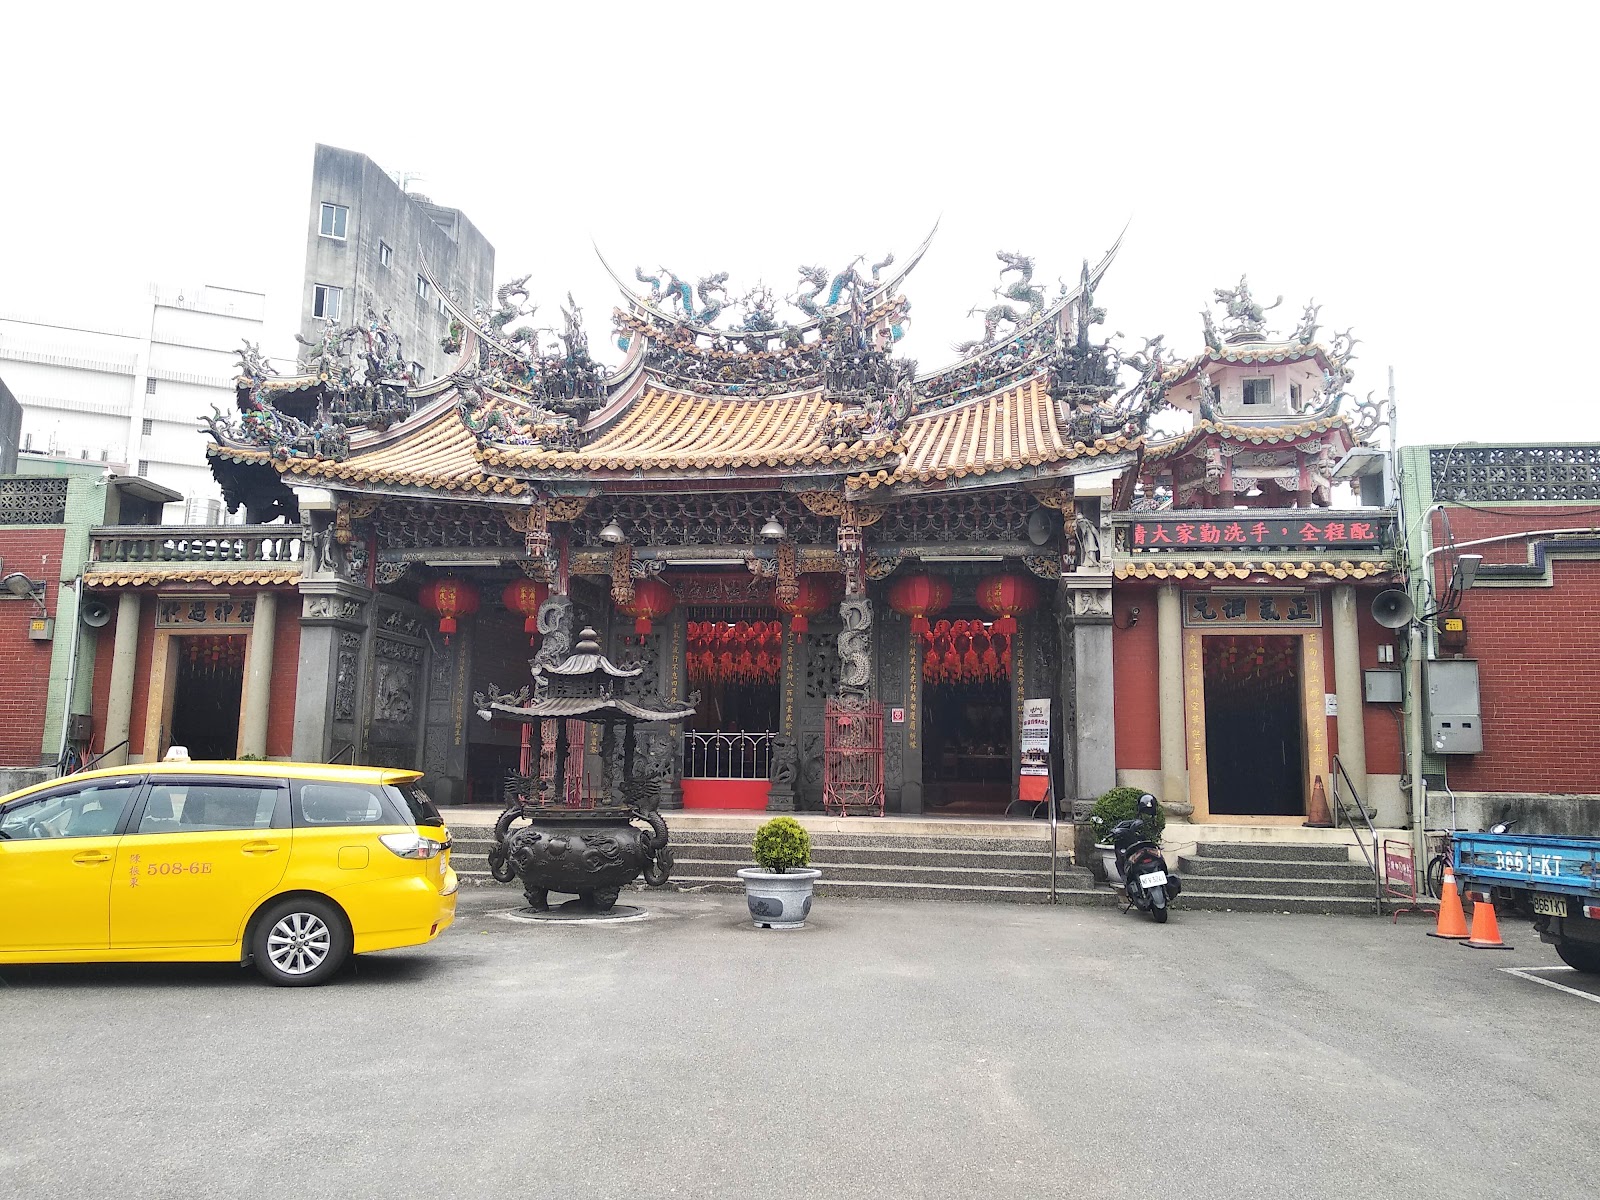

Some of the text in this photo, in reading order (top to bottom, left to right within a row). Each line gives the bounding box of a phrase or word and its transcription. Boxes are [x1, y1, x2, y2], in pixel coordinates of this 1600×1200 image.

[1134, 522, 1379, 544] 請大家勤洗手，全程配
[147, 862, 213, 876] 508-6E
